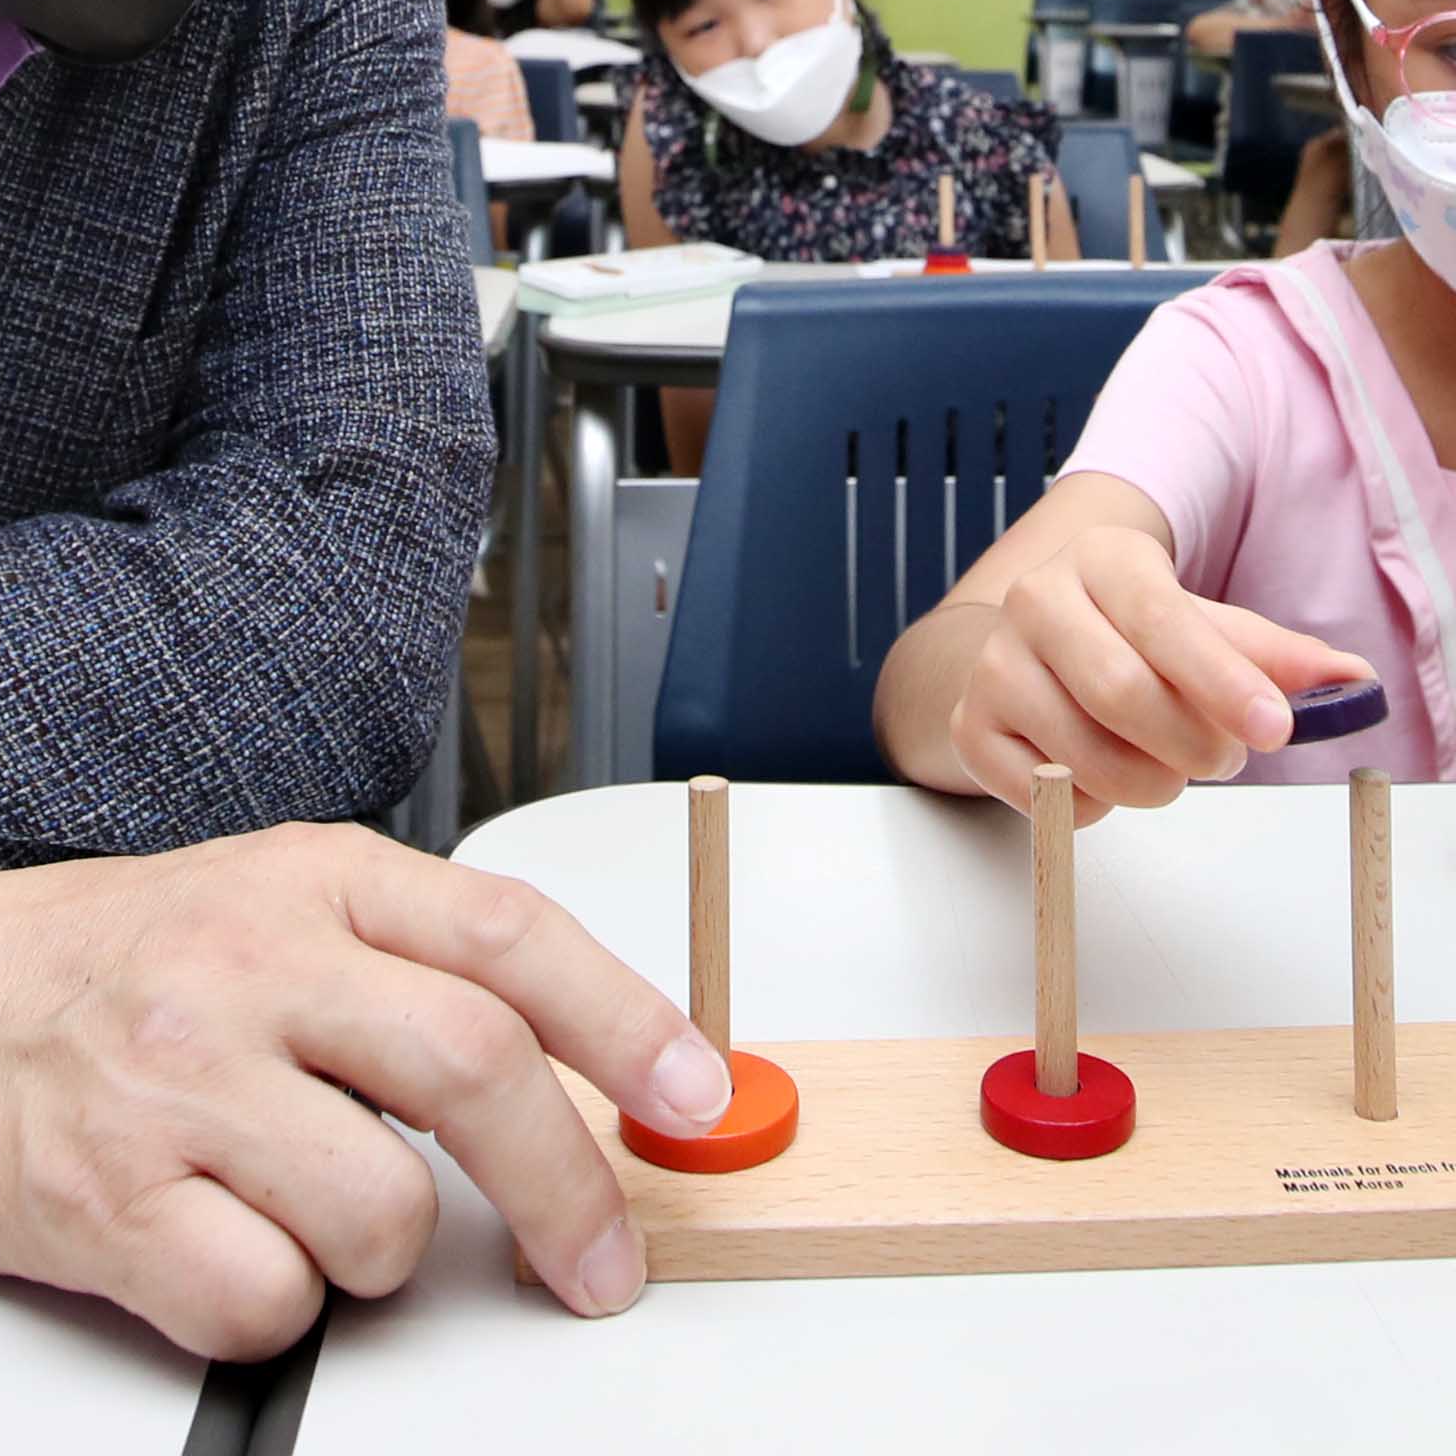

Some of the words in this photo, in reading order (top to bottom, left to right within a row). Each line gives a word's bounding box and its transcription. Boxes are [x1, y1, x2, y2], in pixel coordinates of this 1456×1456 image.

[1275, 1166, 1353, 1181] Materials
[1358, 1164, 1381, 1177] for
[1387, 1161, 1438, 1176] Beech
[1283, 1180, 1330, 1195] Made
[1335, 1179, 1351, 1191] in
[1356, 1178, 1405, 1192] Korea
